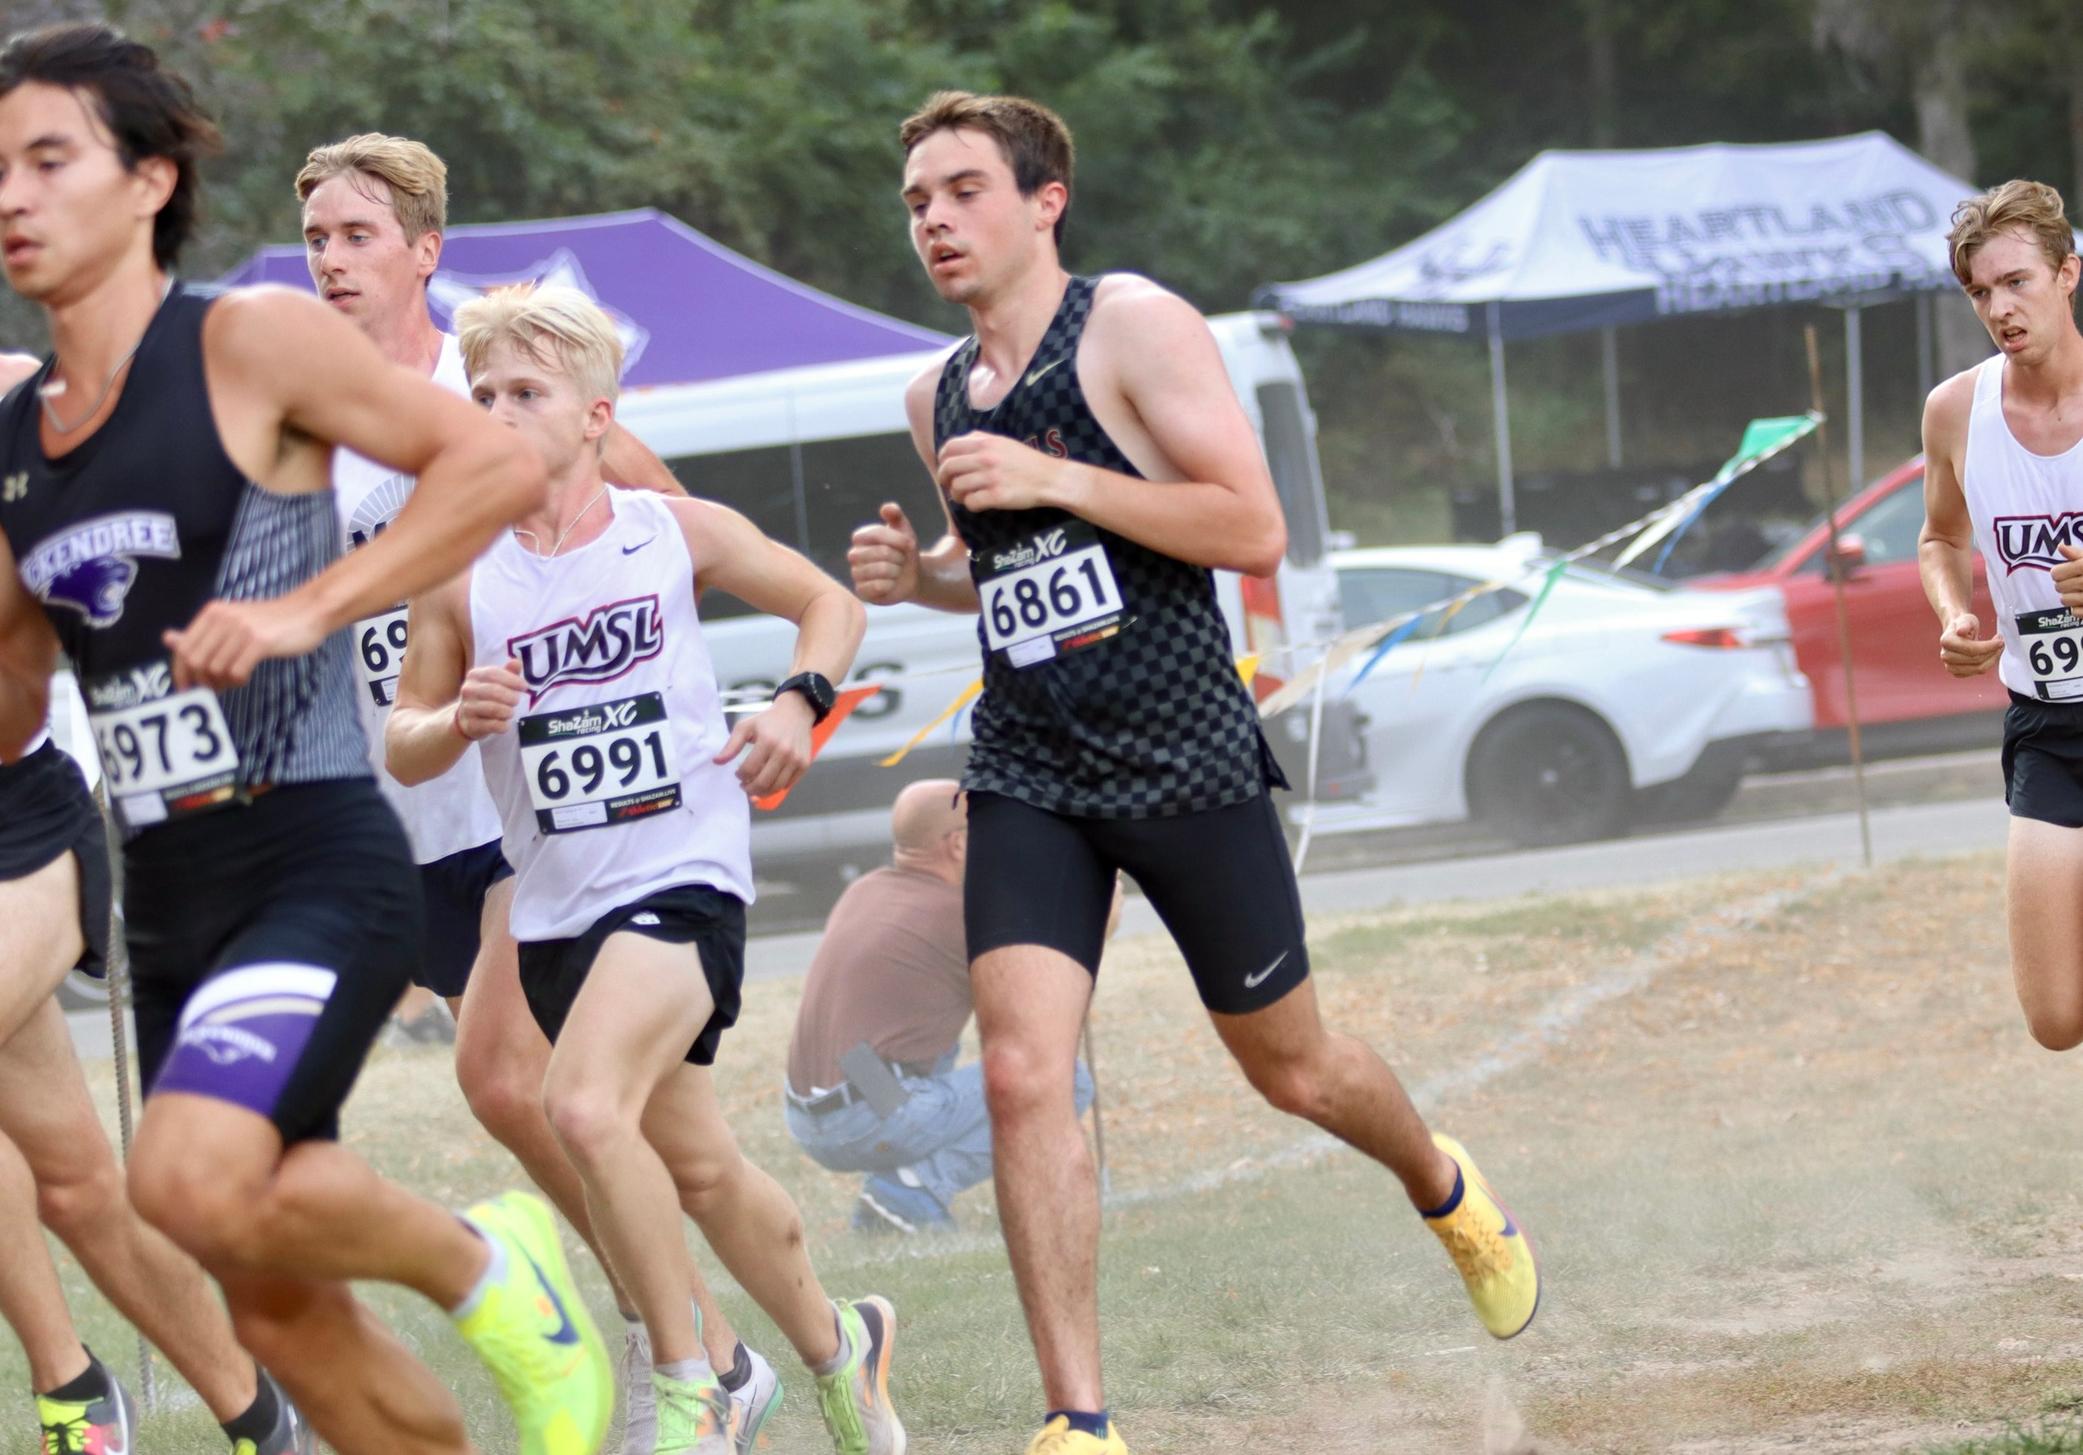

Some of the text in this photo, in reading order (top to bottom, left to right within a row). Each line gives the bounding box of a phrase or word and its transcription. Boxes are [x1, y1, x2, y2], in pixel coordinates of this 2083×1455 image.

[1580, 190, 1938, 262] HEARTLAND
[1033, 528, 1067, 562] XC
[992, 557, 1107, 638] 6861
[517, 604, 661, 687] UMSL
[548, 699, 638, 734] ShaZam XC
[537, 731, 668, 800] 6991
